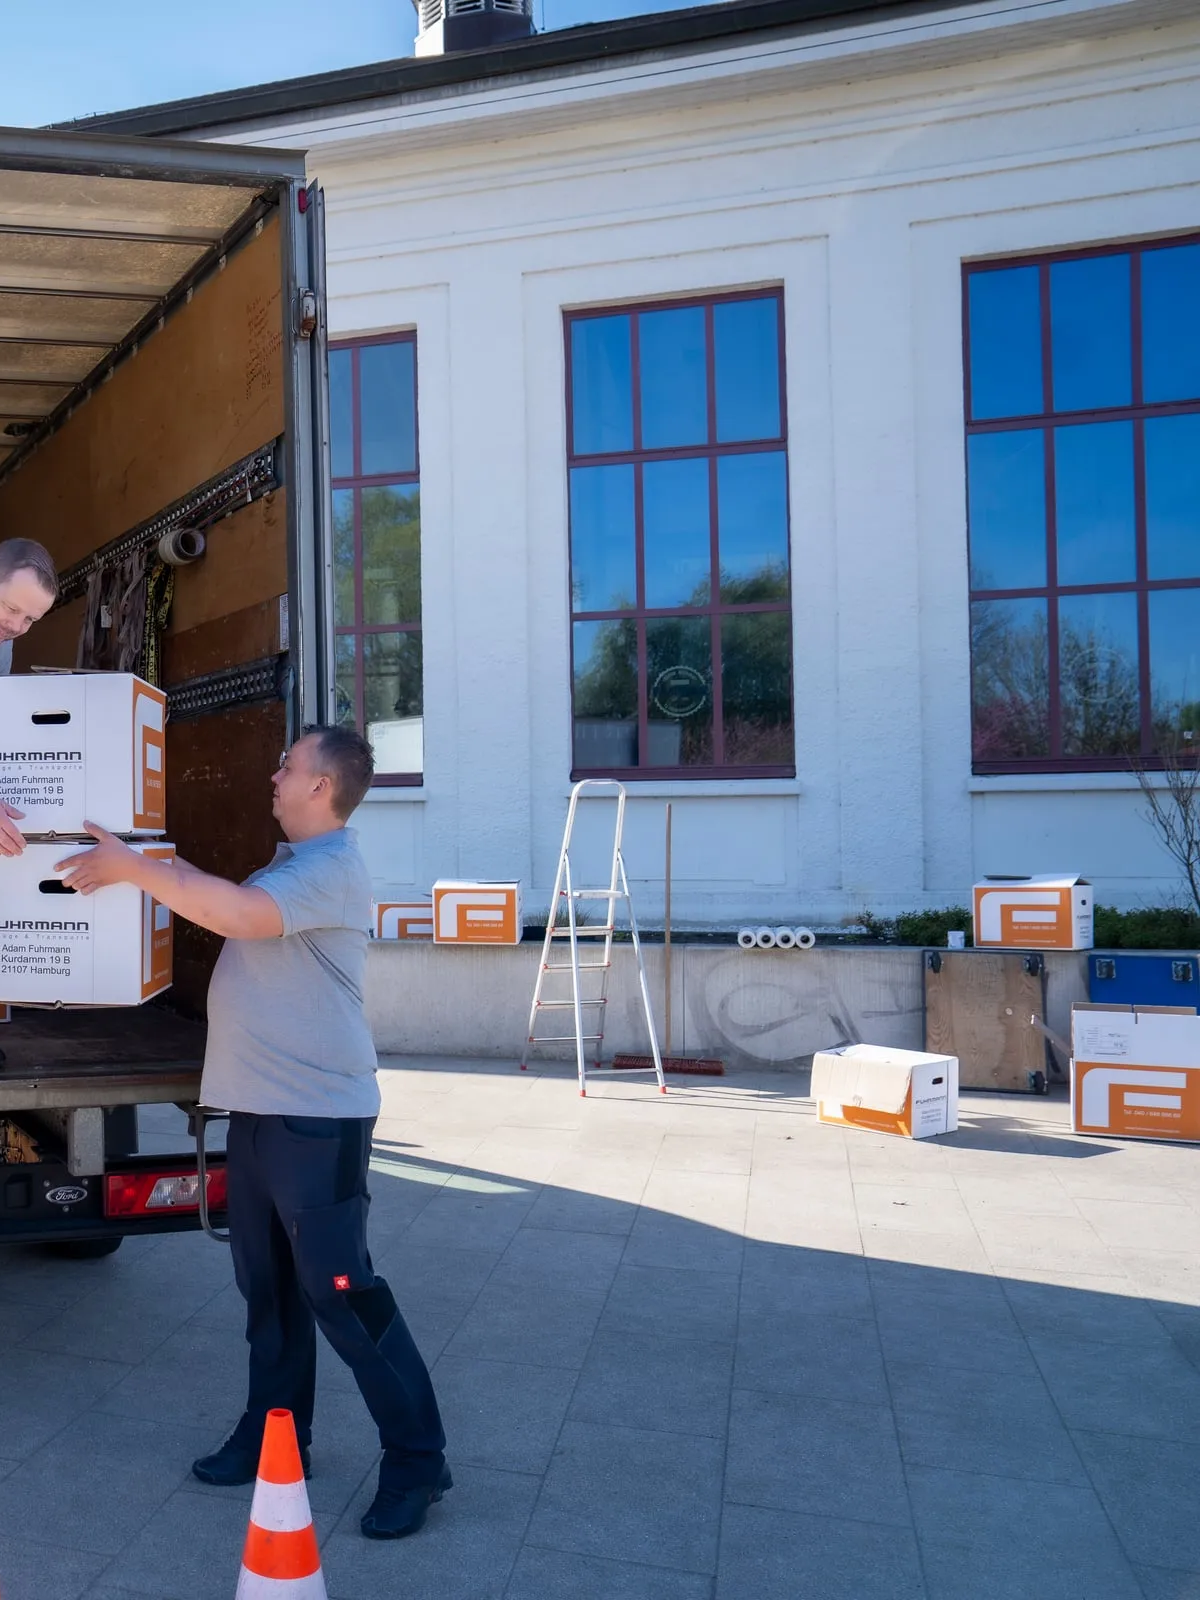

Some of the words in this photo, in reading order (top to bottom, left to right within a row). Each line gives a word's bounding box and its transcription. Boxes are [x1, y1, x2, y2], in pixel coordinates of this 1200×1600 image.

[21, 776, 64, 784] Fuhrmann
[43, 786, 54, 794] 19
[56, 786, 64, 794] B
[1, 797, 21, 805] 107
[24, 797, 64, 806] Hamburg
[2, 944, 26, 952] Adam
[28, 944, 71, 953] Fuhrmann
[1, 954, 46, 963] Kurdamm
[50, 956, 60, 964] 19
[63, 956, 71, 964] B
[1, 965, 27, 974] 21107
[30, 966, 71, 976] Hamburg
[56, 1189, 79, 1200] Ford
